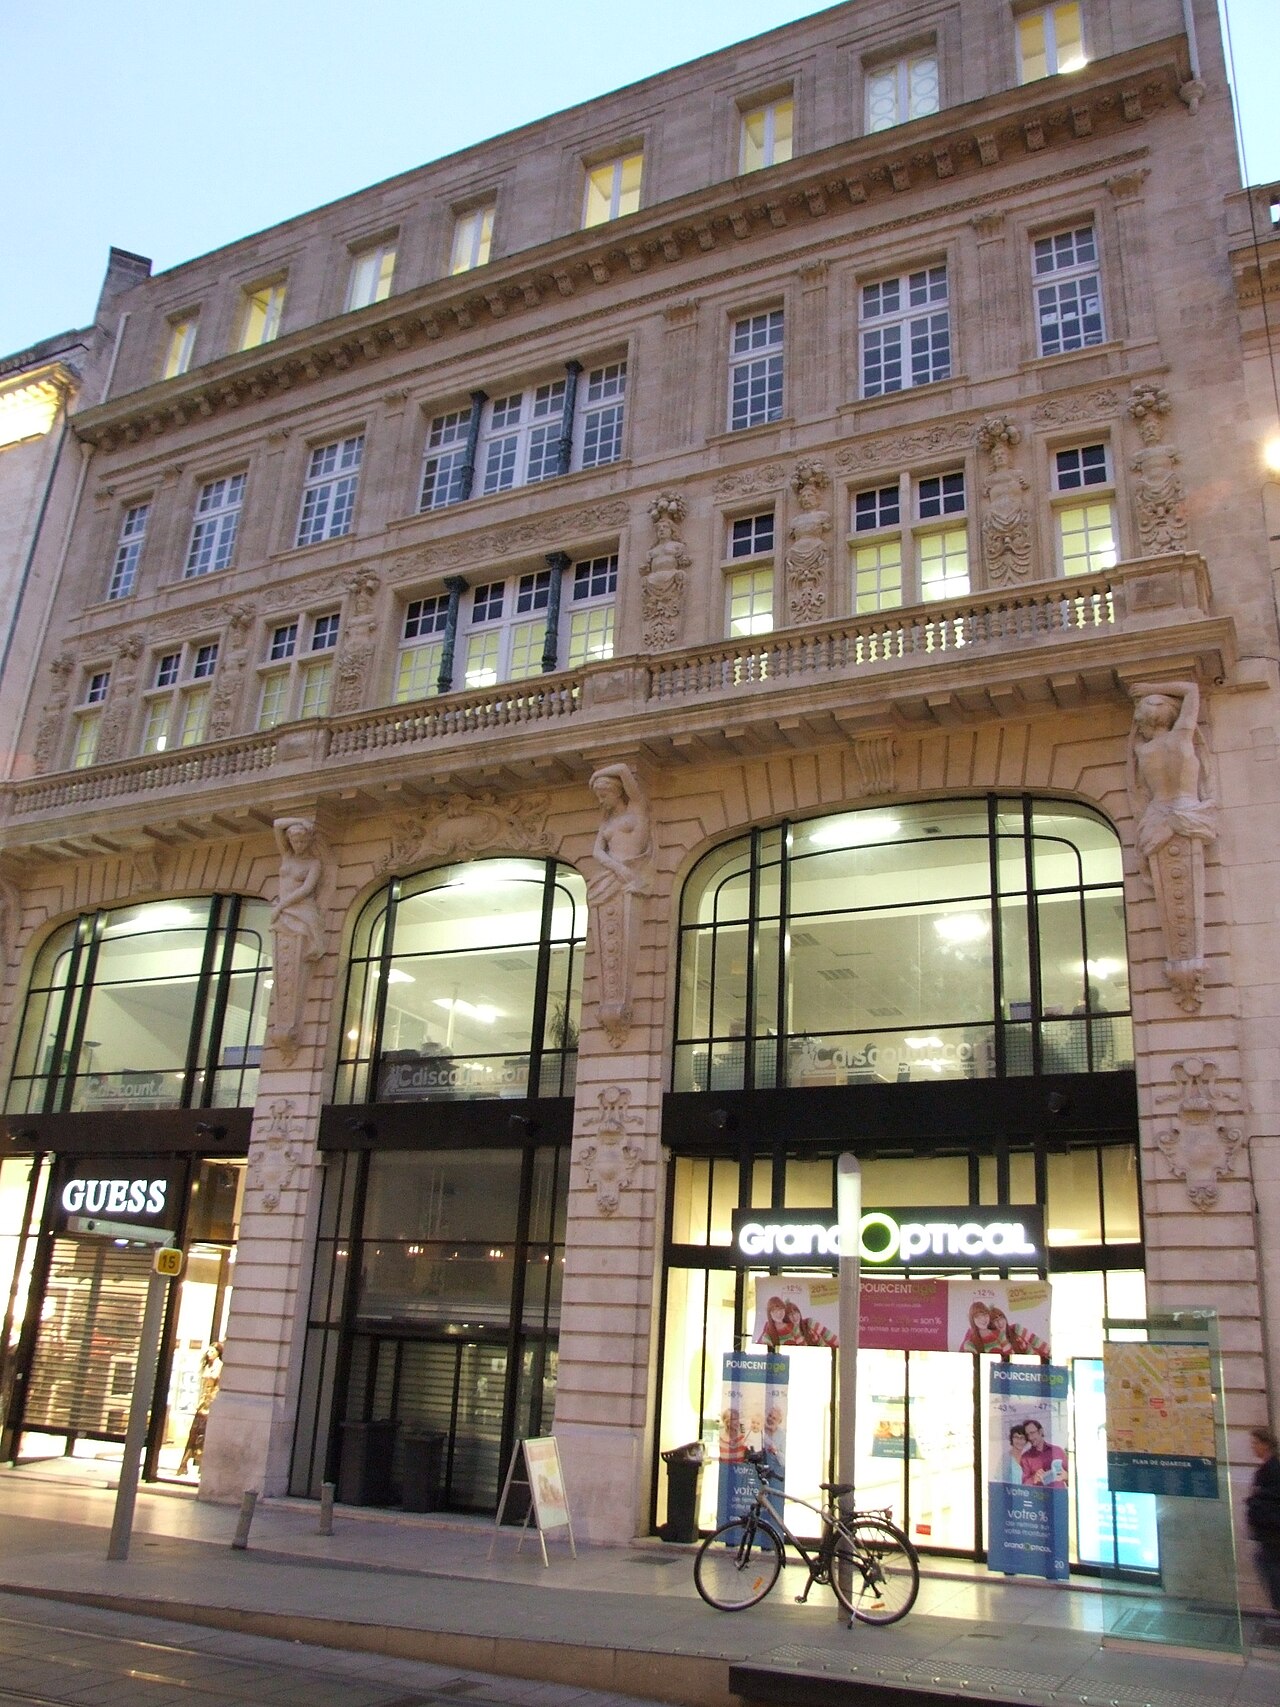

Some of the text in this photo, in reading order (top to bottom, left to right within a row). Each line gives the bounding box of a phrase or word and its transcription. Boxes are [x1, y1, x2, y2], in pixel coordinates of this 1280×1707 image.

[62, 1179, 167, 1213] GUESS
[161, 1254, 176, 1269] 15
[1132, 1458, 1149, 1466] PLAN
[1160, 1460, 1191, 1468] QUARTIER
[1054, 1560, 1065, 1569] 20
